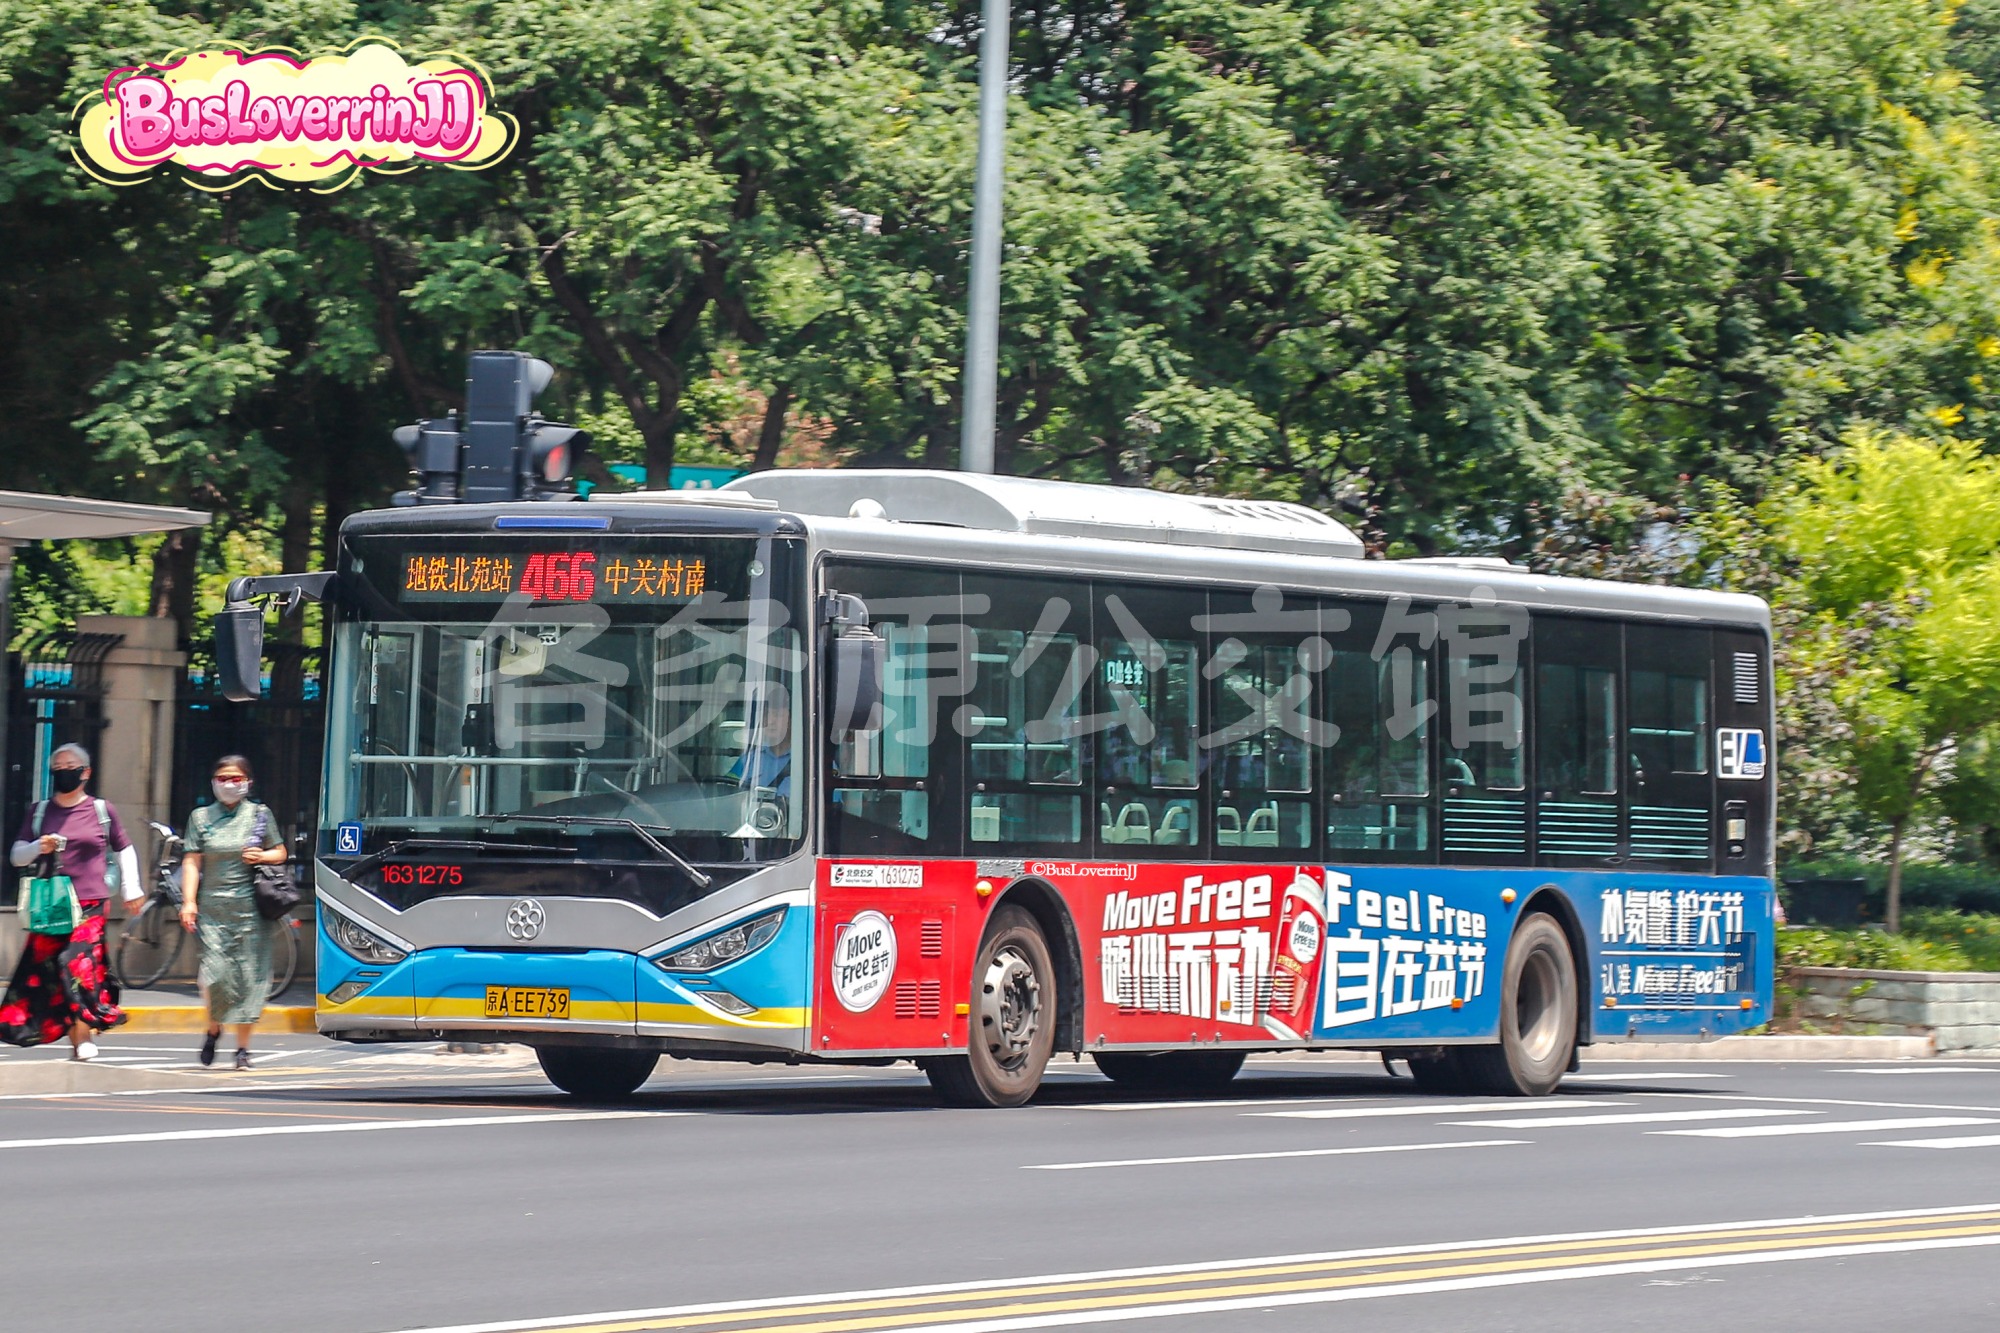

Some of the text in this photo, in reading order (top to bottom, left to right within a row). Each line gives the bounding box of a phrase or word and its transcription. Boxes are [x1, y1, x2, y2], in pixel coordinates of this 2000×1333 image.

[406, 556, 512, 593] 地铁北苑站
[519, 551, 596, 600] 466
[604, 558, 705, 596] 中关村南
[381, 865, 462, 885] 1631275
[881, 868, 920, 885] 1631275
[1102, 874, 1272, 932] Move Free
[1326, 869, 1487, 938] Feel Free
[847, 929, 882, 961] Move
[841, 957, 869, 989] Free
[1323, 928, 1487, 1029] 自在益节
